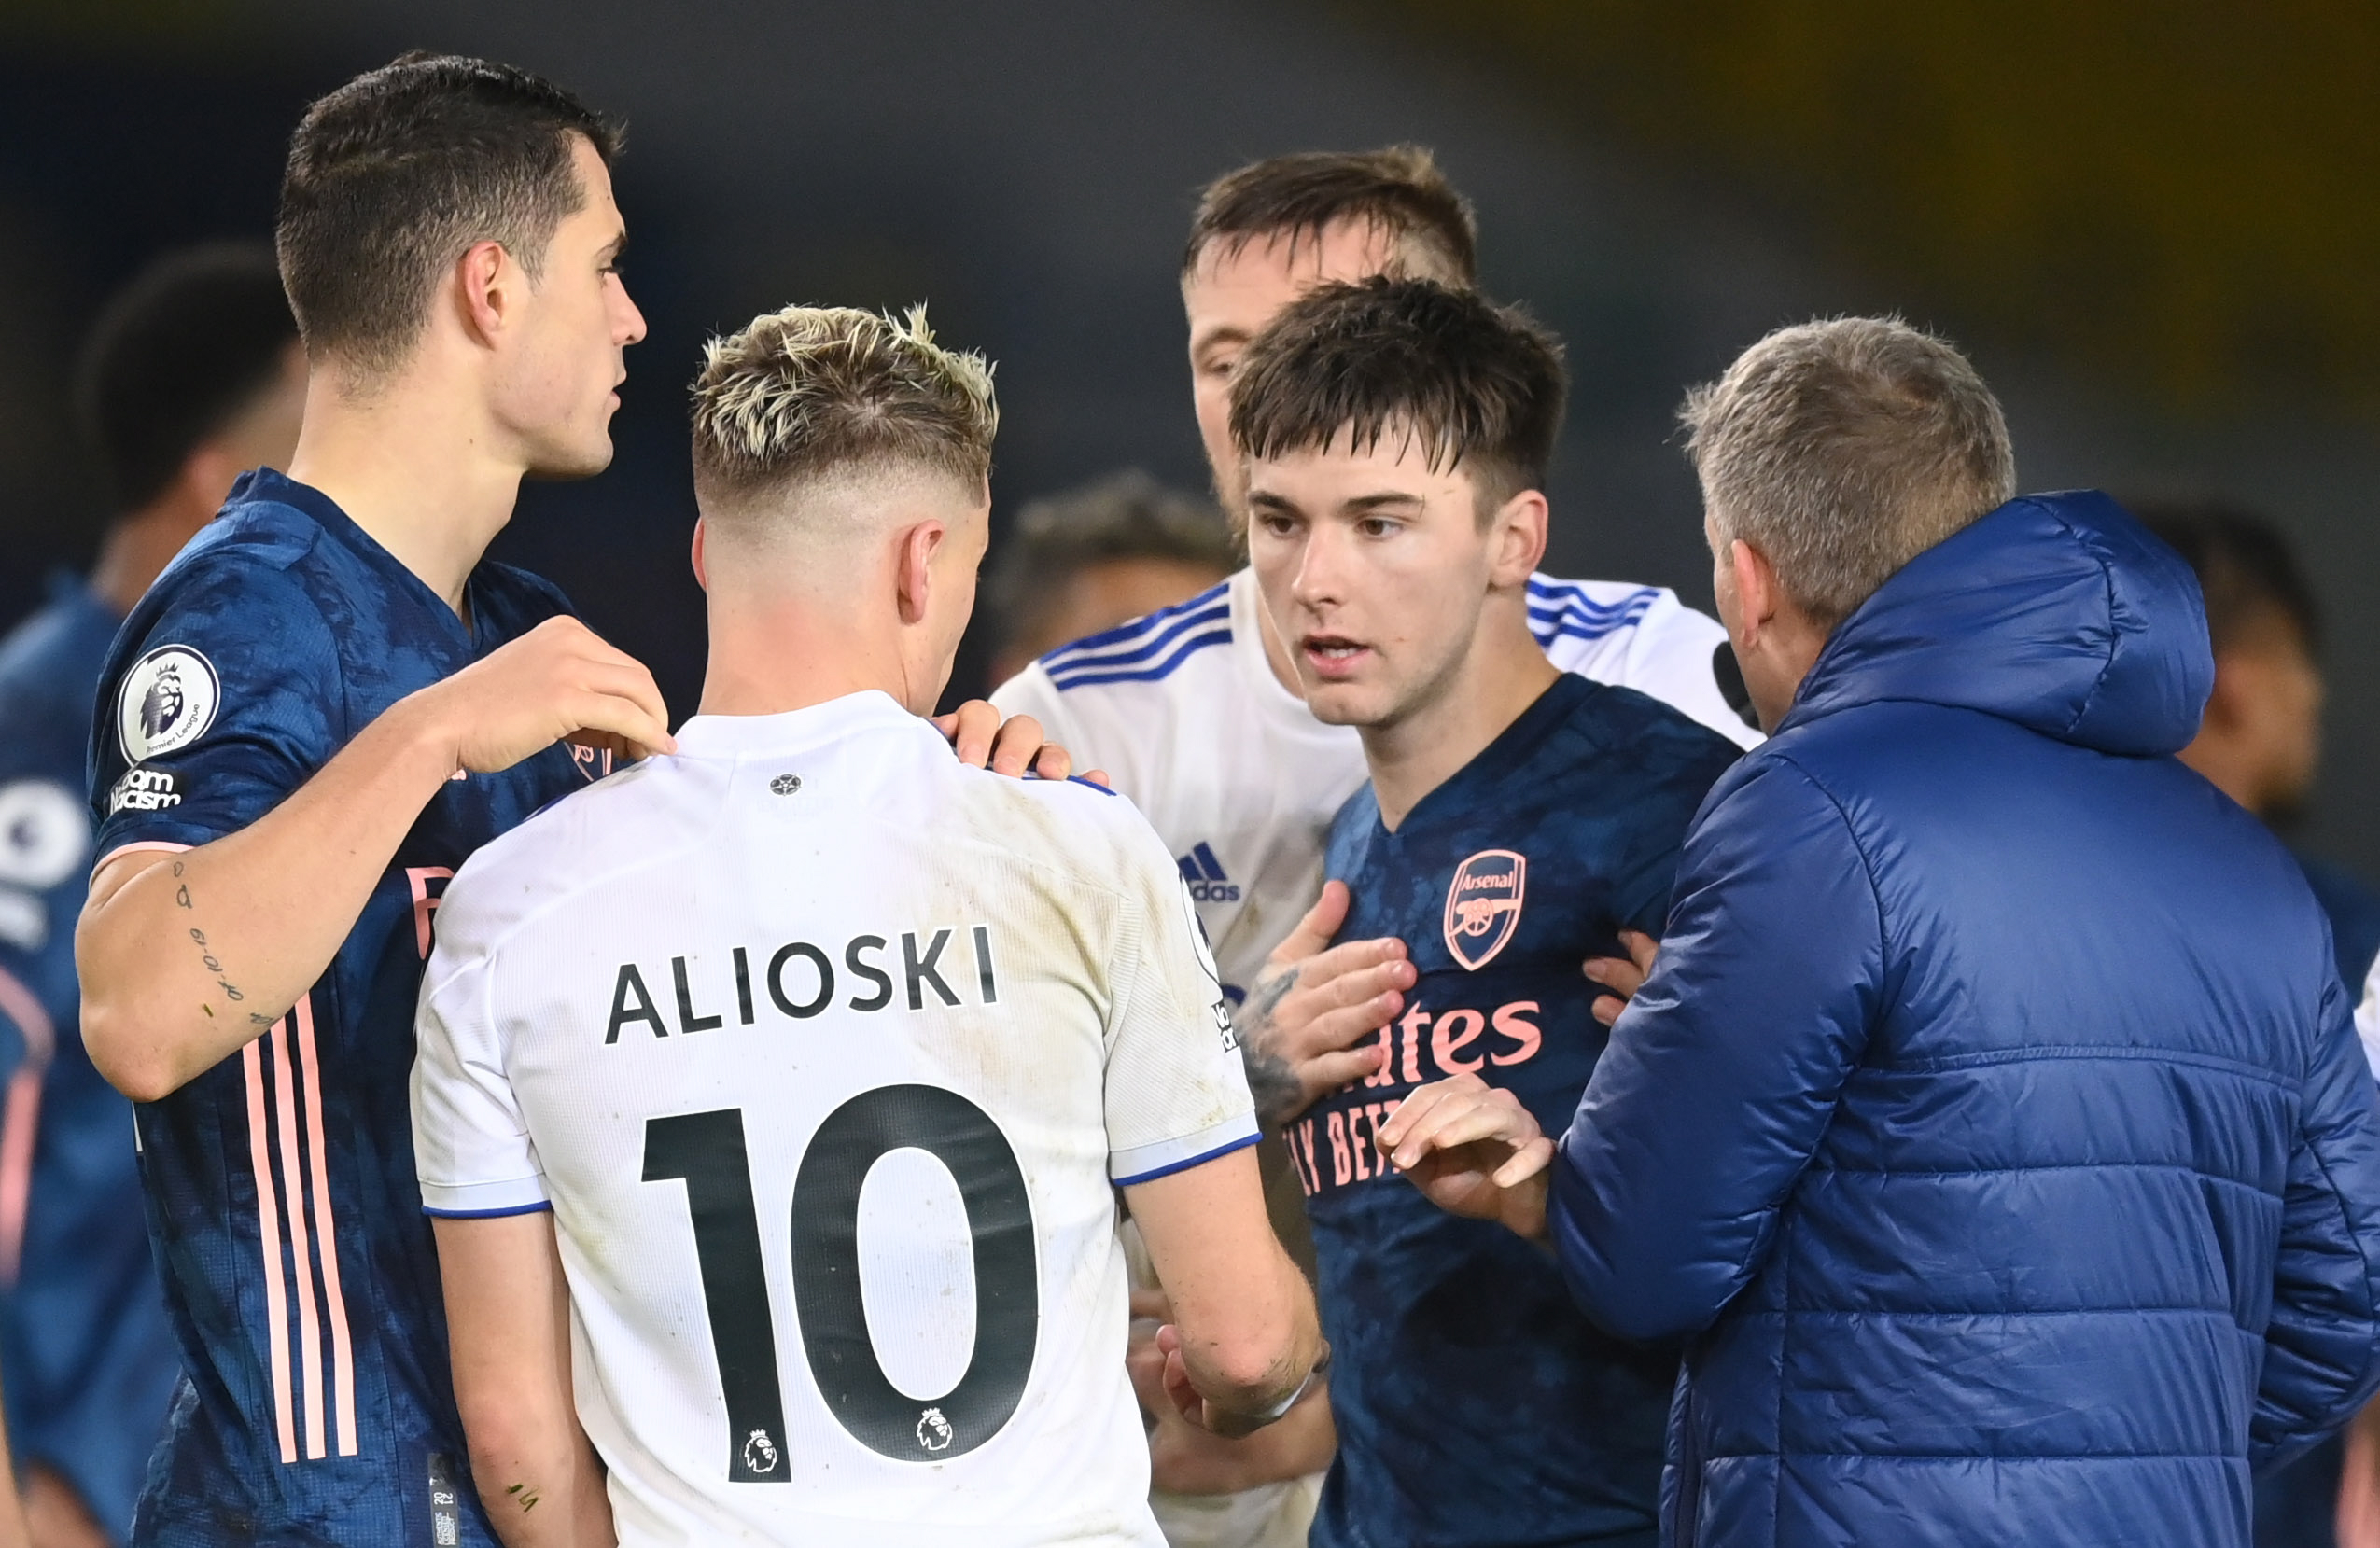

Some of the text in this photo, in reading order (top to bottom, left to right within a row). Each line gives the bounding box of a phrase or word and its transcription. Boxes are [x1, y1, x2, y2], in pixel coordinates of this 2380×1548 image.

[175, 704, 201, 739] League
[1192, 880, 1240, 902] das
[1460, 870, 1514, 891] Arsenal
[603, 926, 998, 1045] ALIOSKI
[1210, 1003, 1230, 1028] No
[1341, 1000, 1542, 1092] ates
[1283, 1119, 1321, 1197] LY
[640, 1082, 1040, 1484] 10
